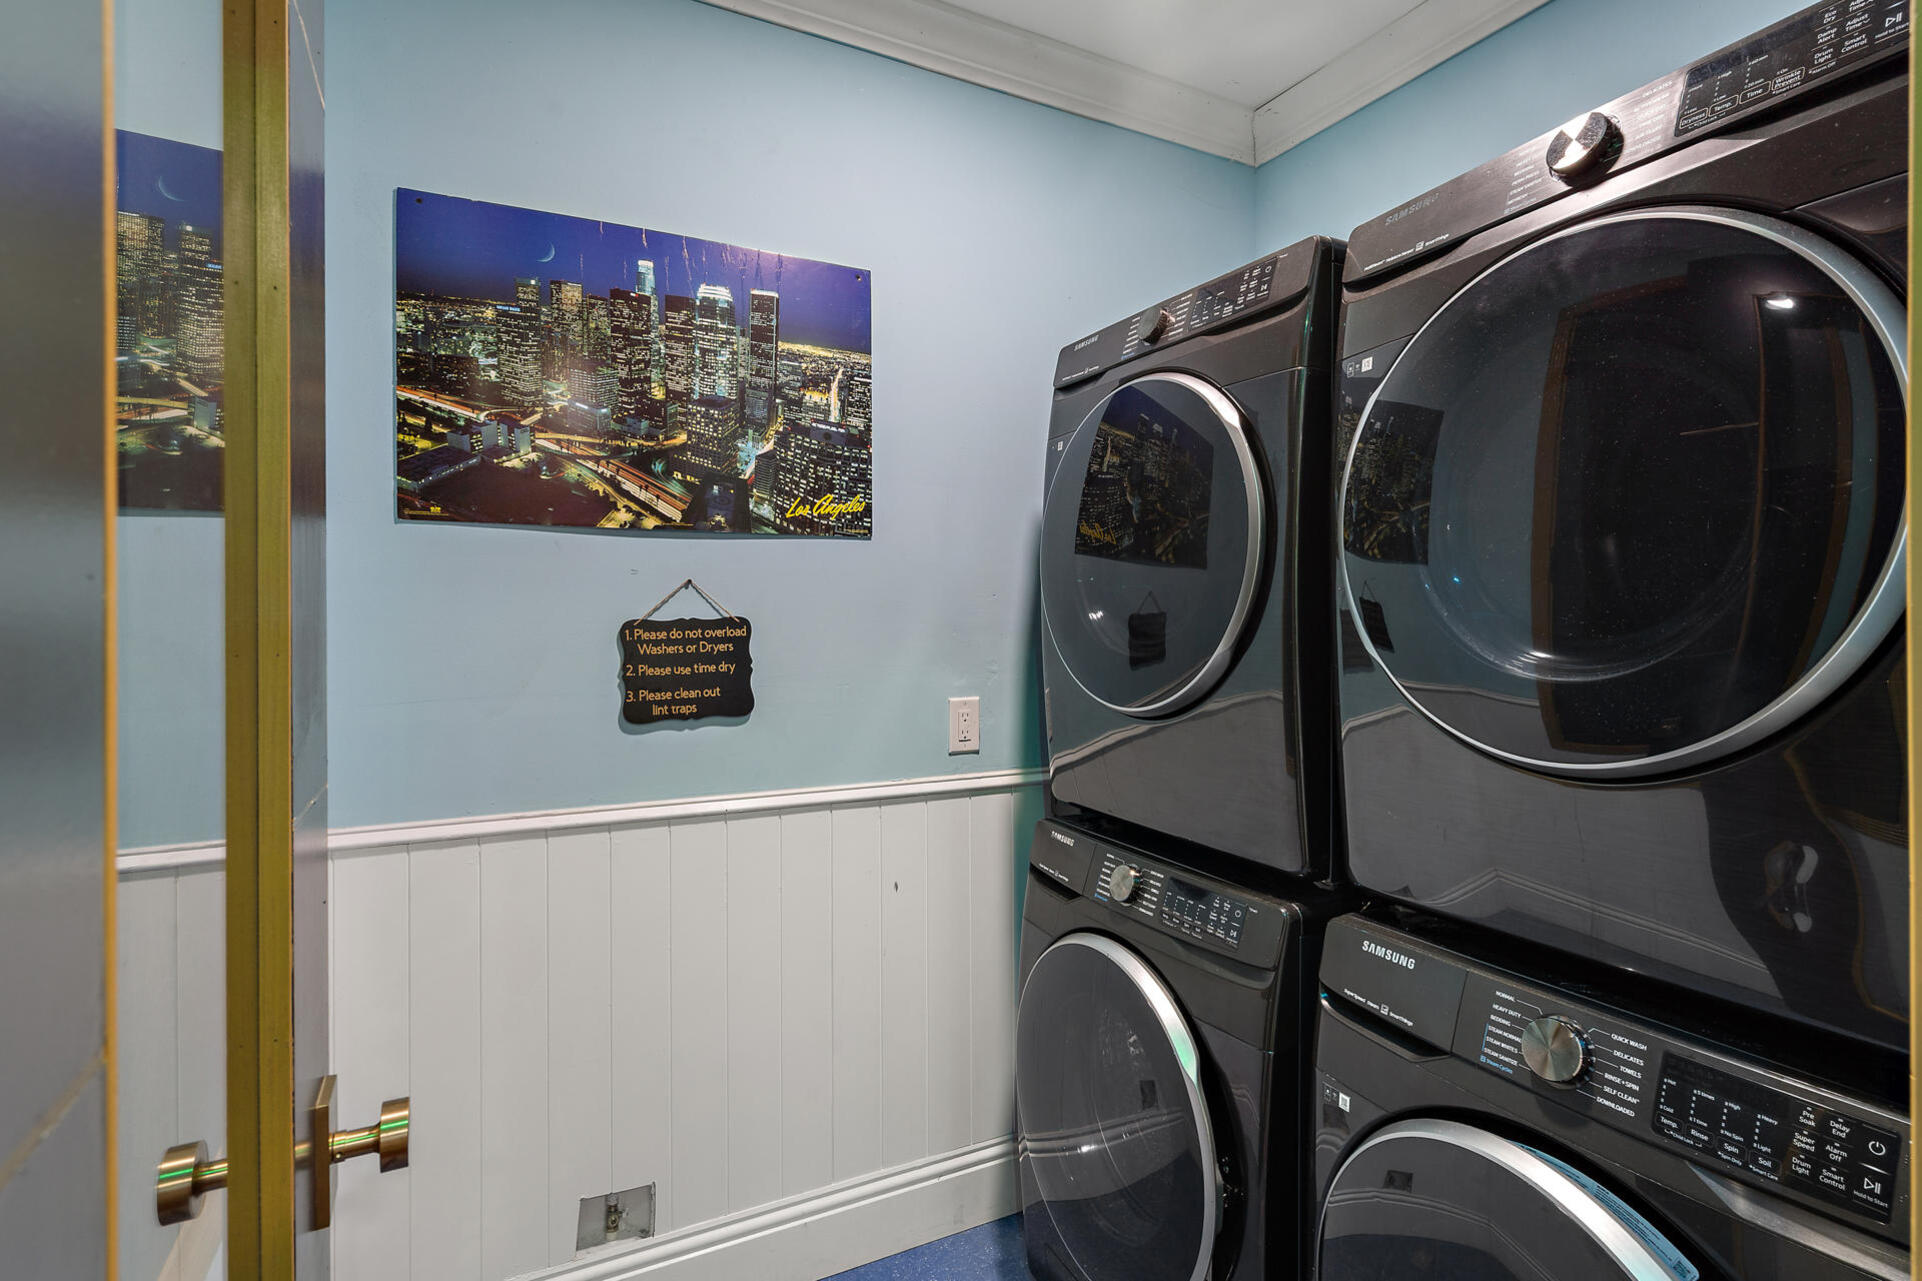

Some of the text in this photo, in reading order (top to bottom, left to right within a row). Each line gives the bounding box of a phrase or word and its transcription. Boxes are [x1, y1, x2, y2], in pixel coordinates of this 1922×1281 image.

[1823, 15, 1836, 24] Dry
[1824, 10, 1837, 19] Eco
[1845, 13, 1869, 27] Adjust
[1817, 27, 1838, 39] Damp
[1845, 22, 1863, 32] Time
[1817, 33, 1835, 44] Alert
[1844, 33, 1867, 46] Smart
[1841, 38, 1868, 53] Control
[1814, 48, 1834, 59] Drum
[1814, 53, 1832, 65] Light
[1774, 75, 1801, 89] Prevent
[1775, 70, 1801, 84] Wrinkle
[1747, 88, 1764, 99] Time
[1714, 101, 1733, 112] Temp.
[1681, 112, 1706, 126] Dryness
[1384, 192, 1440, 226] SAMSUNG
[1073, 334, 1100, 352] SAMSUNG
[785, 494, 866, 521] Los Angeles
[625, 625, 747, 641] 1. Please do not overload
[637, 641, 734, 655] Washers or Dryers
[626, 660, 736, 677] 2. Please use time dry
[626, 686, 721, 702] 3. Please clean out
[652, 703, 697, 716] lint traps
[1362, 940, 1416, 970] SAMSUNG
[1495, 990, 1516, 1002] NORMAL
[1492, 1003, 1522, 1019] HEAVY DUTY
[1490, 1014, 1511, 1027] BEDDING
[1611, 1033, 1648, 1051] QUICK WASH
[1613, 1049, 1645, 1067] DELICATES
[1620, 1065, 1642, 1079] TOWELS
[1604, 1072, 1621, 1085] RINSE
[1625, 1081, 1640, 1092] SPIN
[1603, 1085, 1617, 1095] SELF
[1596, 1096, 1636, 1117] DOWNLOADED
[1663, 1105, 1674, 1114] Cold
[1728, 1102, 1742, 1111] High
[1761, 1114, 1779, 1126] Heavy
[1799, 1116, 1816, 1127] Soak
[1802, 1110, 1816, 1120] Pre
[1660, 1116, 1678, 1129] Temp.
[1829, 1120, 1851, 1134] Delay
[1690, 1129, 1709, 1142] Rinse
[1732, 1133, 1744, 1143] Spin
[1794, 1132, 1816, 1145] Super
[1832, 1128, 1847, 1139] End
[1723, 1142, 1739, 1155] Spin
[1757, 1143, 1772, 1154] Light
[1792, 1138, 1815, 1152] Speed
[1825, 1144, 1848, 1158] Alarm
[1758, 1157, 1772, 1169] Soil
[1792, 1156, 1812, 1169] Drum
[1829, 1153, 1842, 1163] Off
[1792, 1164, 1810, 1177] Light
[1822, 1168, 1844, 1182] Smart
[1819, 1175, 1846, 1191] Control
[1853, 1189, 1867, 1200] Hold
[1874, 1198, 1888, 1209] Start
